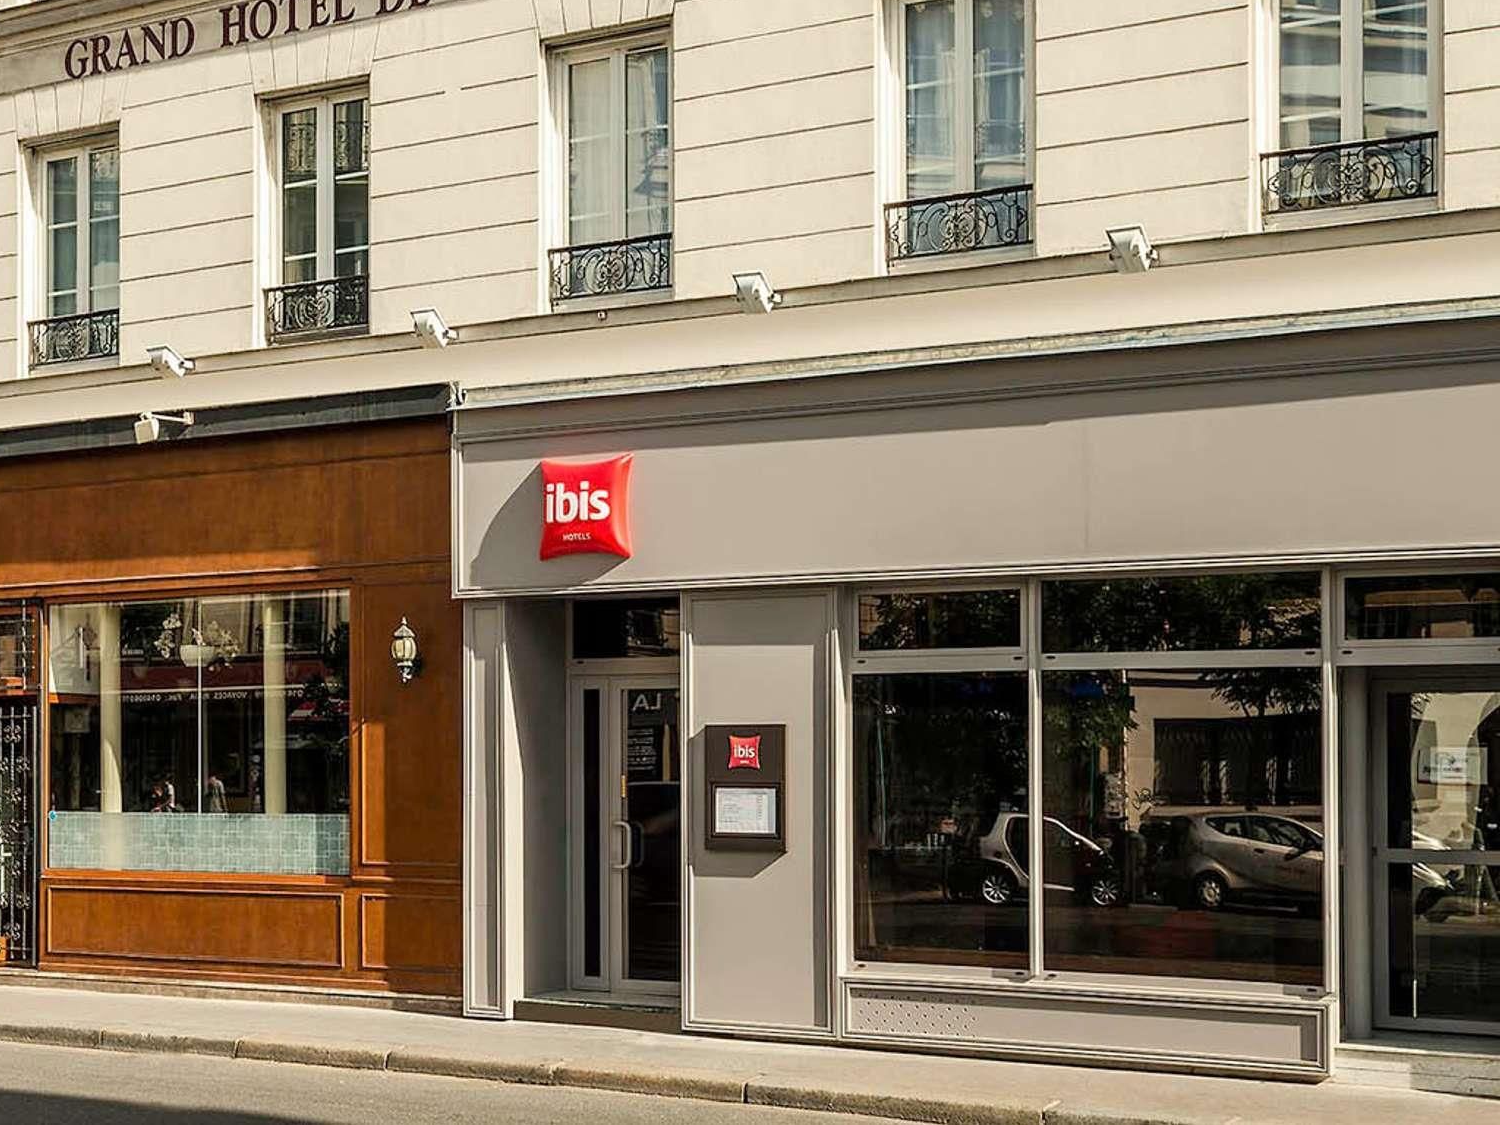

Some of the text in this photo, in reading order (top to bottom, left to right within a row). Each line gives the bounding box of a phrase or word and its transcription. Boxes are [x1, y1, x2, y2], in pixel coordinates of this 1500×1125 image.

[64, 17, 196, 80] GRAND
[545, 480, 611, 524] ibis
[733, 744, 756, 758] ibis
